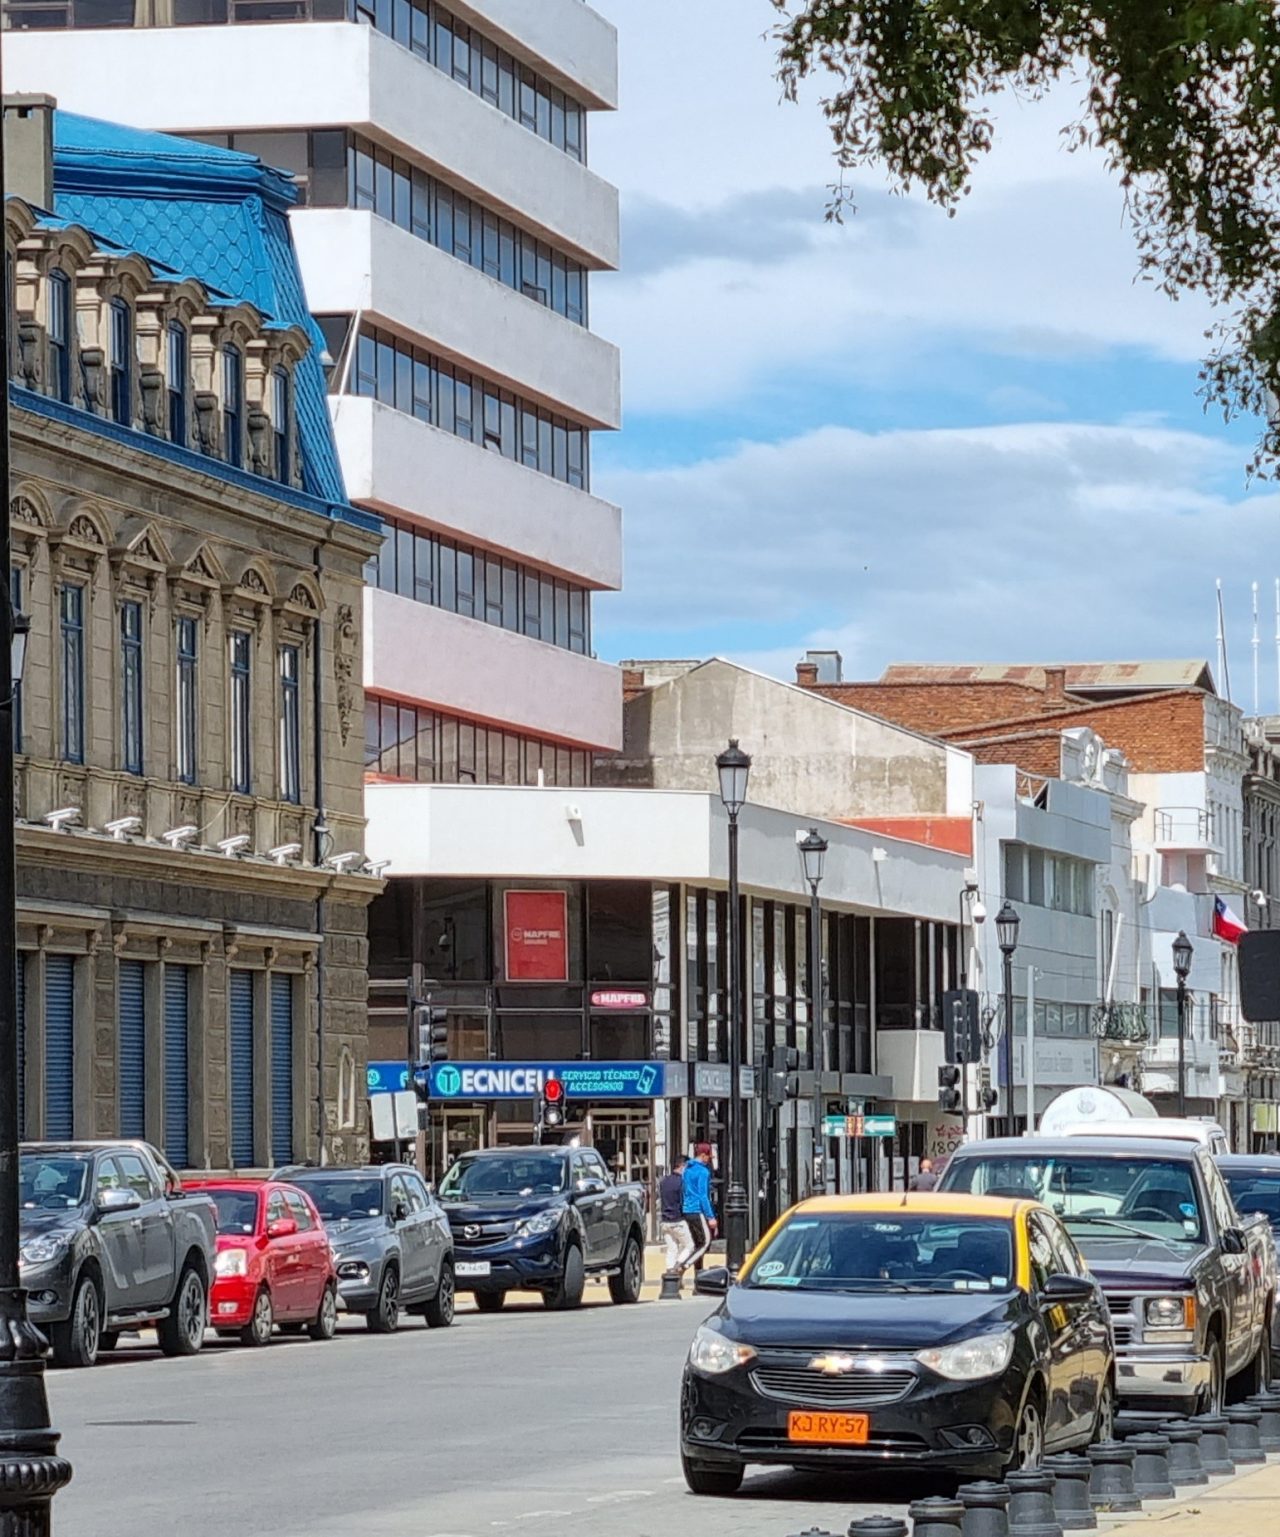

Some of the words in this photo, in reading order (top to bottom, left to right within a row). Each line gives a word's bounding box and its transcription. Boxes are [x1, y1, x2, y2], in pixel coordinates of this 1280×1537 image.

[601, 993, 645, 1003] MAPFRE
[561, 1070, 601, 1080] SERVICIO
[603, 1068, 640, 1080] TÉCNICO
[874, 1223, 902, 1232] TAXI
[791, 1415, 812, 1432] KJ
